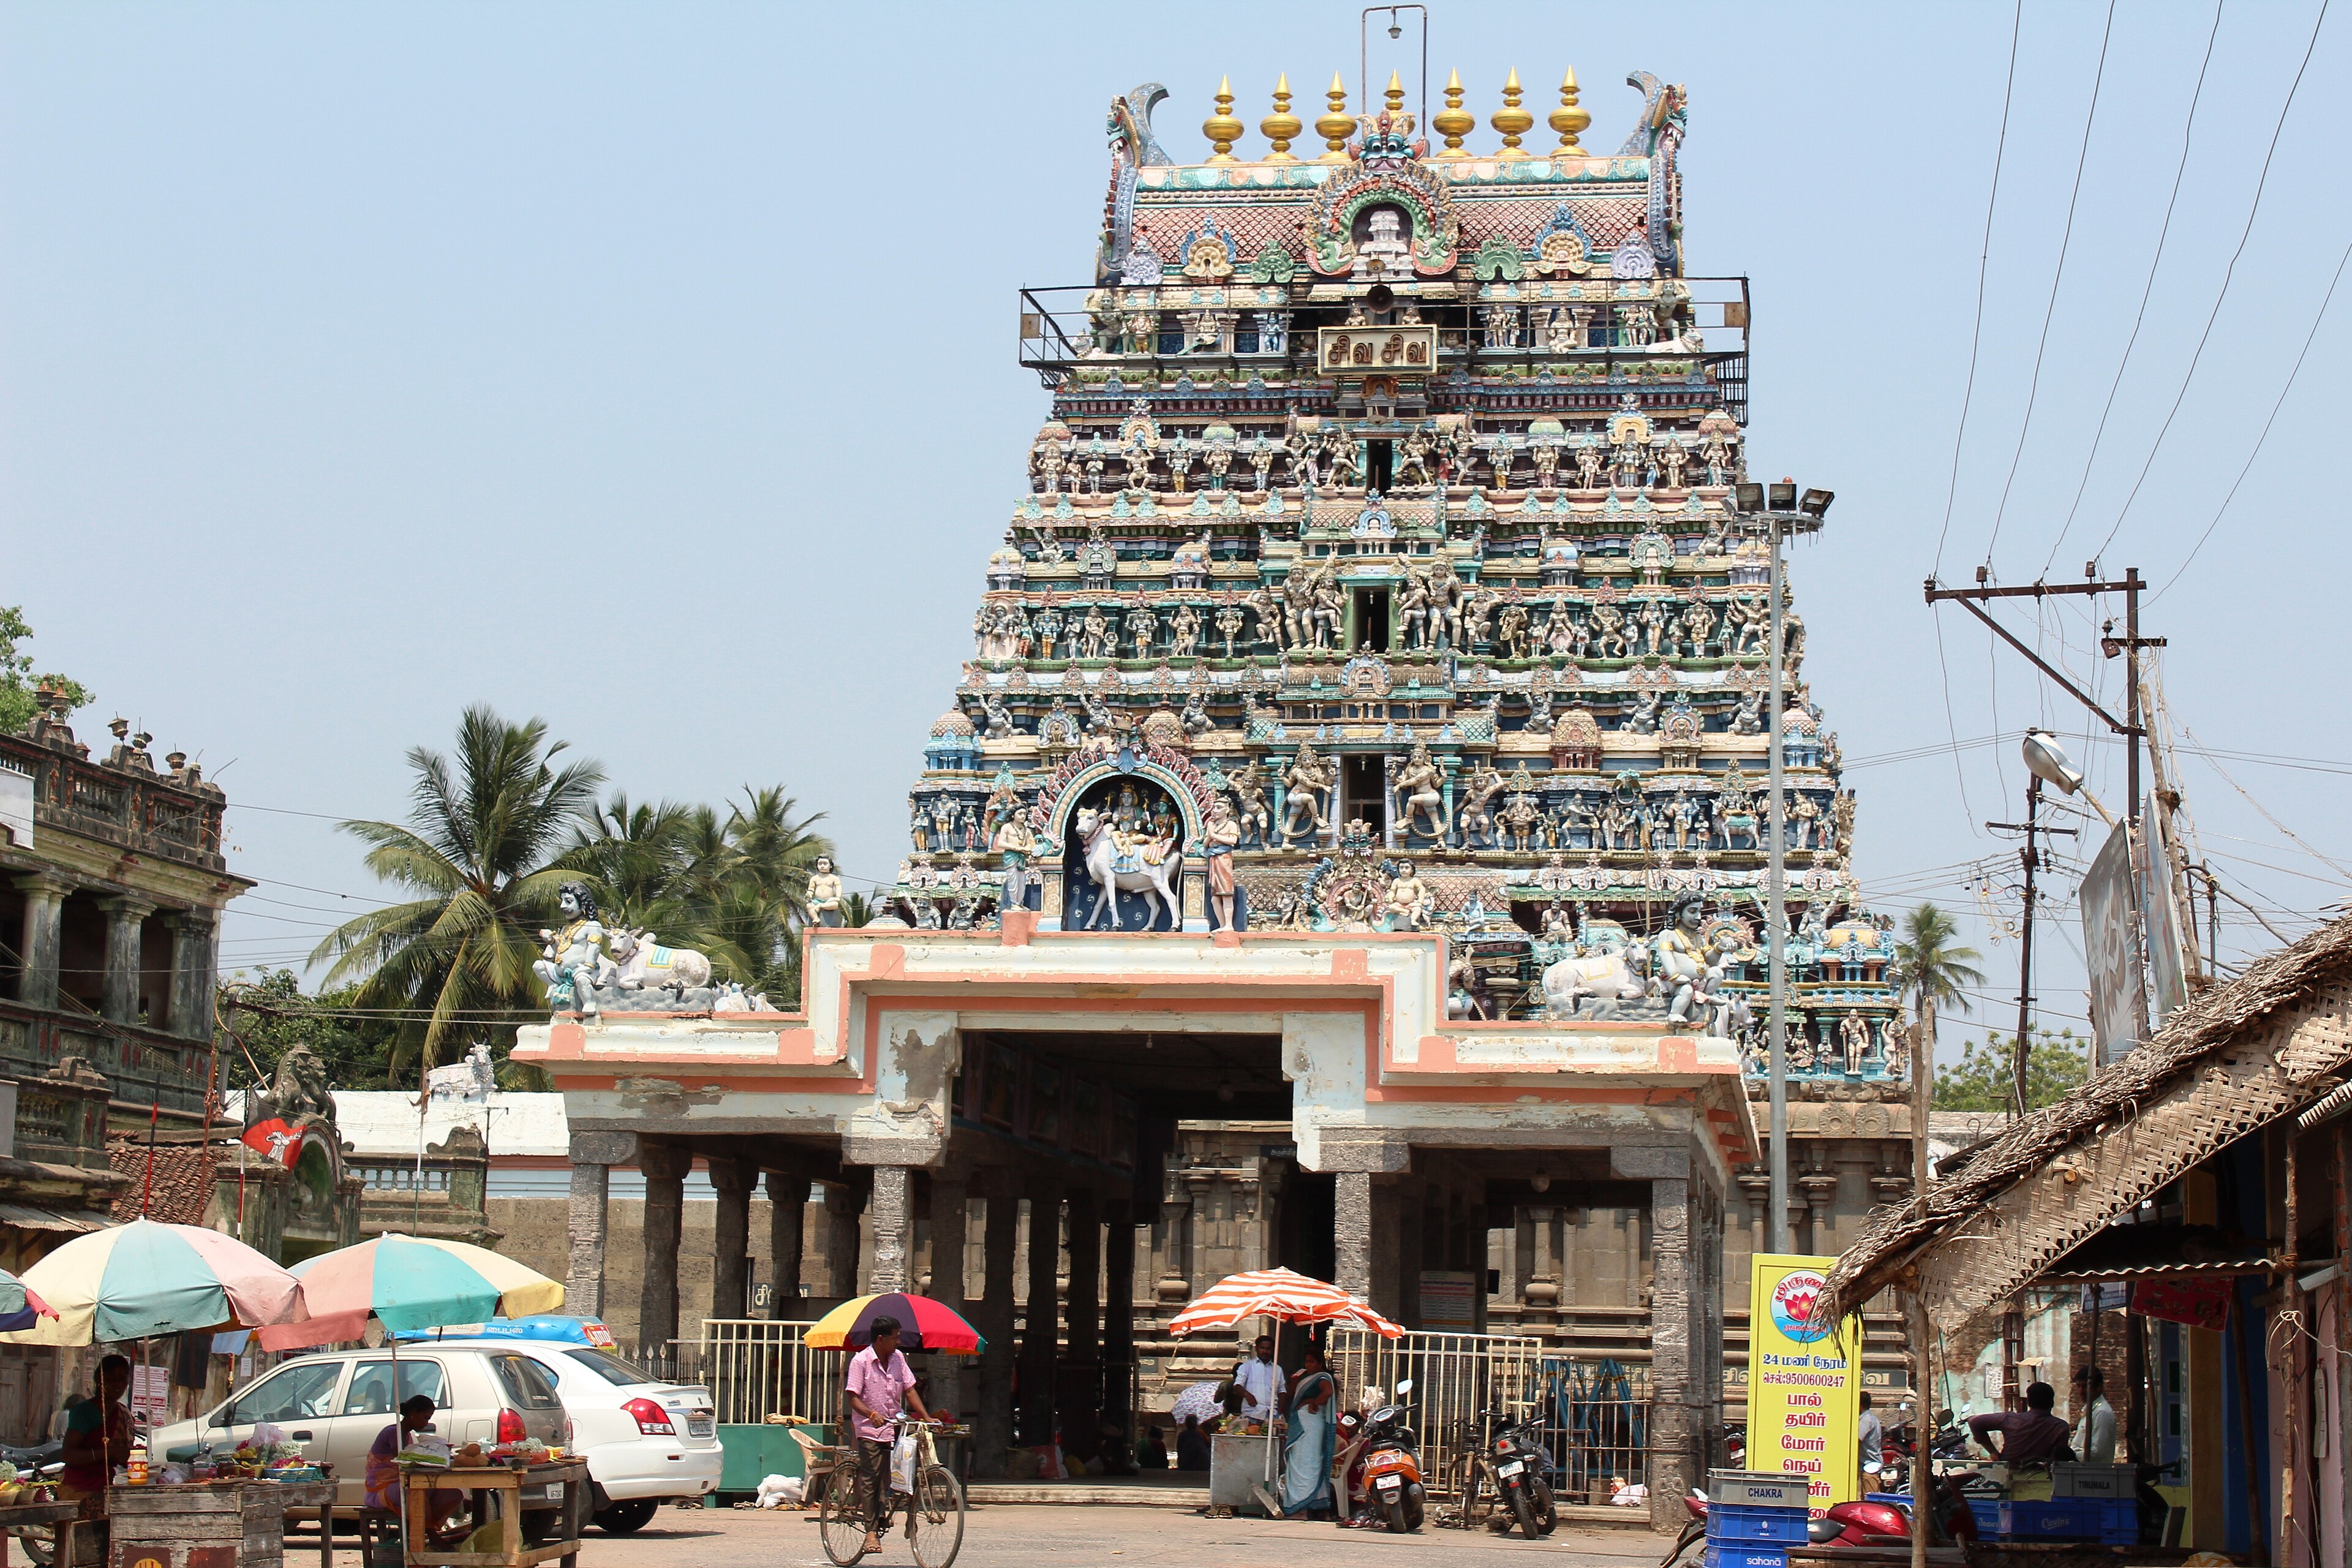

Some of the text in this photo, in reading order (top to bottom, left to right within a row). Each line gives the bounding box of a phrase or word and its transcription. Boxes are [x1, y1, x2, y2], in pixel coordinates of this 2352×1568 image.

[1327, 334, 1427, 364] சிவ சிவ
[486, 1325, 523, 1334] பைப்ஸ்
[1763, 1354, 1779, 1365] 24
[1782, 1354, 1811, 1366] மணி
[1763, 1370, 1845, 1387] செல்:9500600247
[1787, 1392, 1822, 1407] பால்
[1785, 1412, 1826, 1428] தயிர்
[1781, 1434, 1825, 1451] மோர்
[1783, 1457, 1822, 1474] நெய்
[2078, 1480, 2111, 1490] TIRUMALA
[1747, 1487, 1783, 1499] CHAKRA
[1746, 1556, 1782, 1567] sahanā
